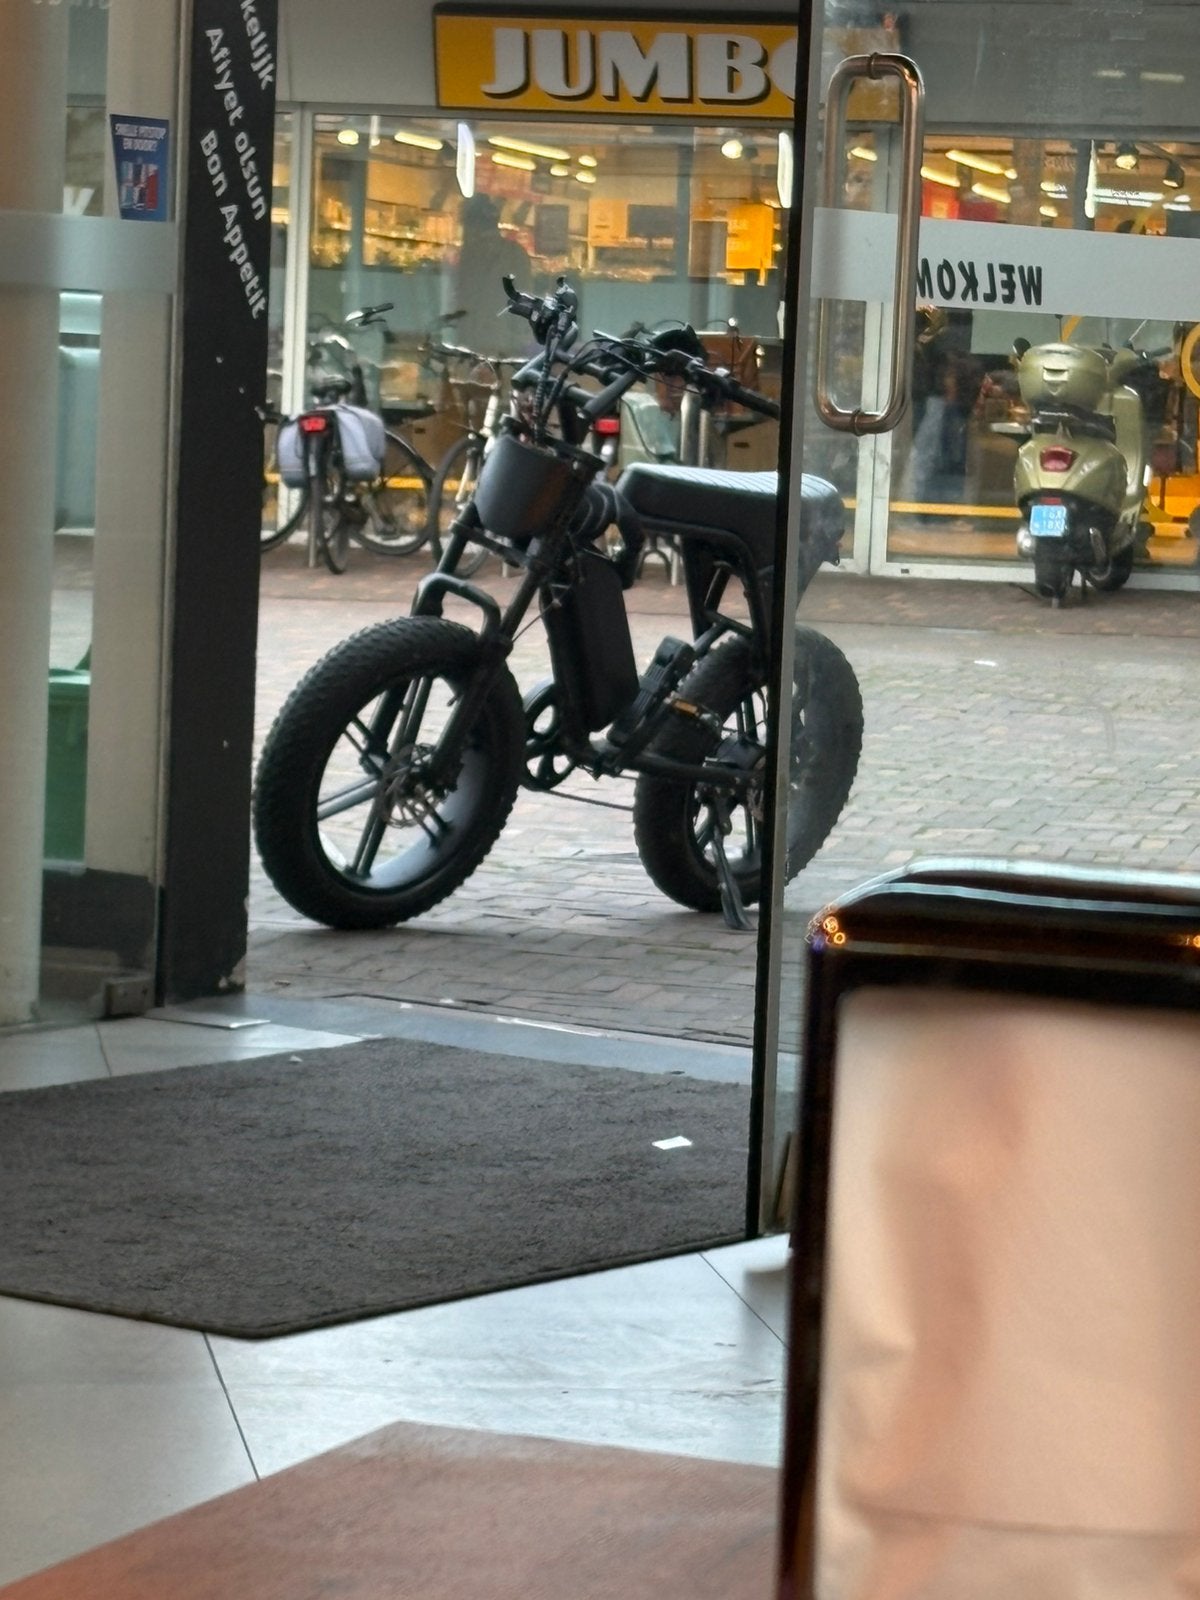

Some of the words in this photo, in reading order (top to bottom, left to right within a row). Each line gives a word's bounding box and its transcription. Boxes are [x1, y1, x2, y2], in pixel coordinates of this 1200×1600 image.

[205, 28, 244, 127] Afiyet
[234, 131, 266, 221] olsun
[200, 130, 228, 198] Bon
[219, 204, 266, 320] Appetit
